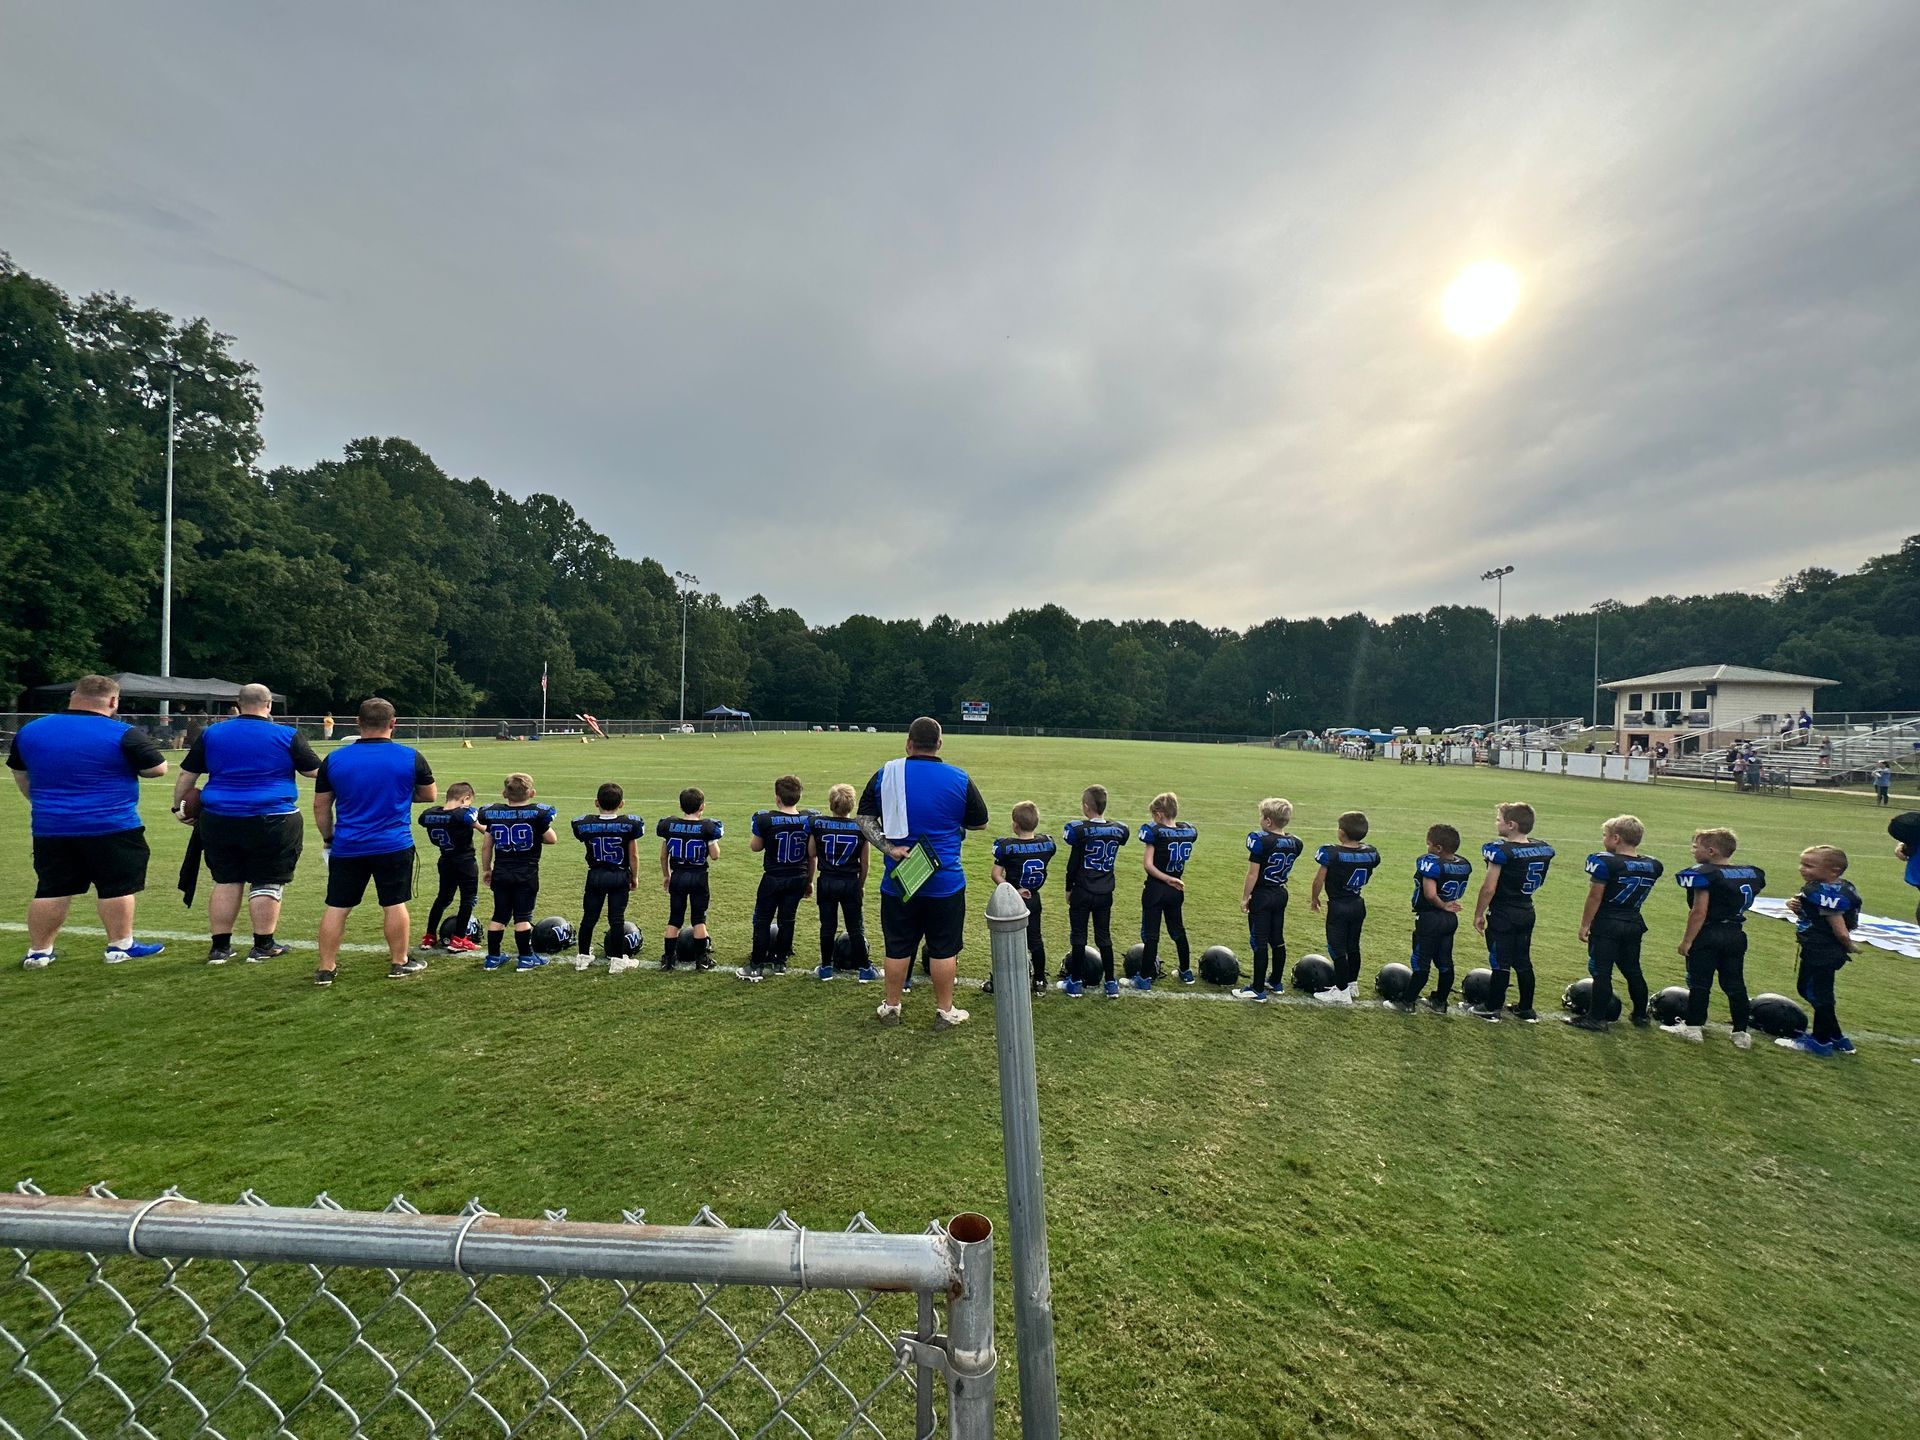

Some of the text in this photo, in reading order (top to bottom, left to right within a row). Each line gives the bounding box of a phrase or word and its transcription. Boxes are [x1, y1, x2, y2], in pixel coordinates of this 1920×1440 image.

[430, 828, 455, 851] 3
[489, 823, 534, 852] 99
[775, 831, 809, 864] 16
[821, 833, 859, 866] 17
[1005, 841, 1055, 855] FRANKLIN
[588, 836, 625, 865] 15
[1019, 858, 1045, 889] 6
[1420, 859, 1433, 872] W
[1586, 859, 1599, 873] W
[1345, 868, 1368, 894] 4
[1520, 861, 1545, 895] 5
[1680, 875, 1694, 888] W
[1608, 876, 1655, 907] 77
[1819, 893, 1841, 909] W
[552, 923, 570, 942] W
[625, 931, 642, 950] W
